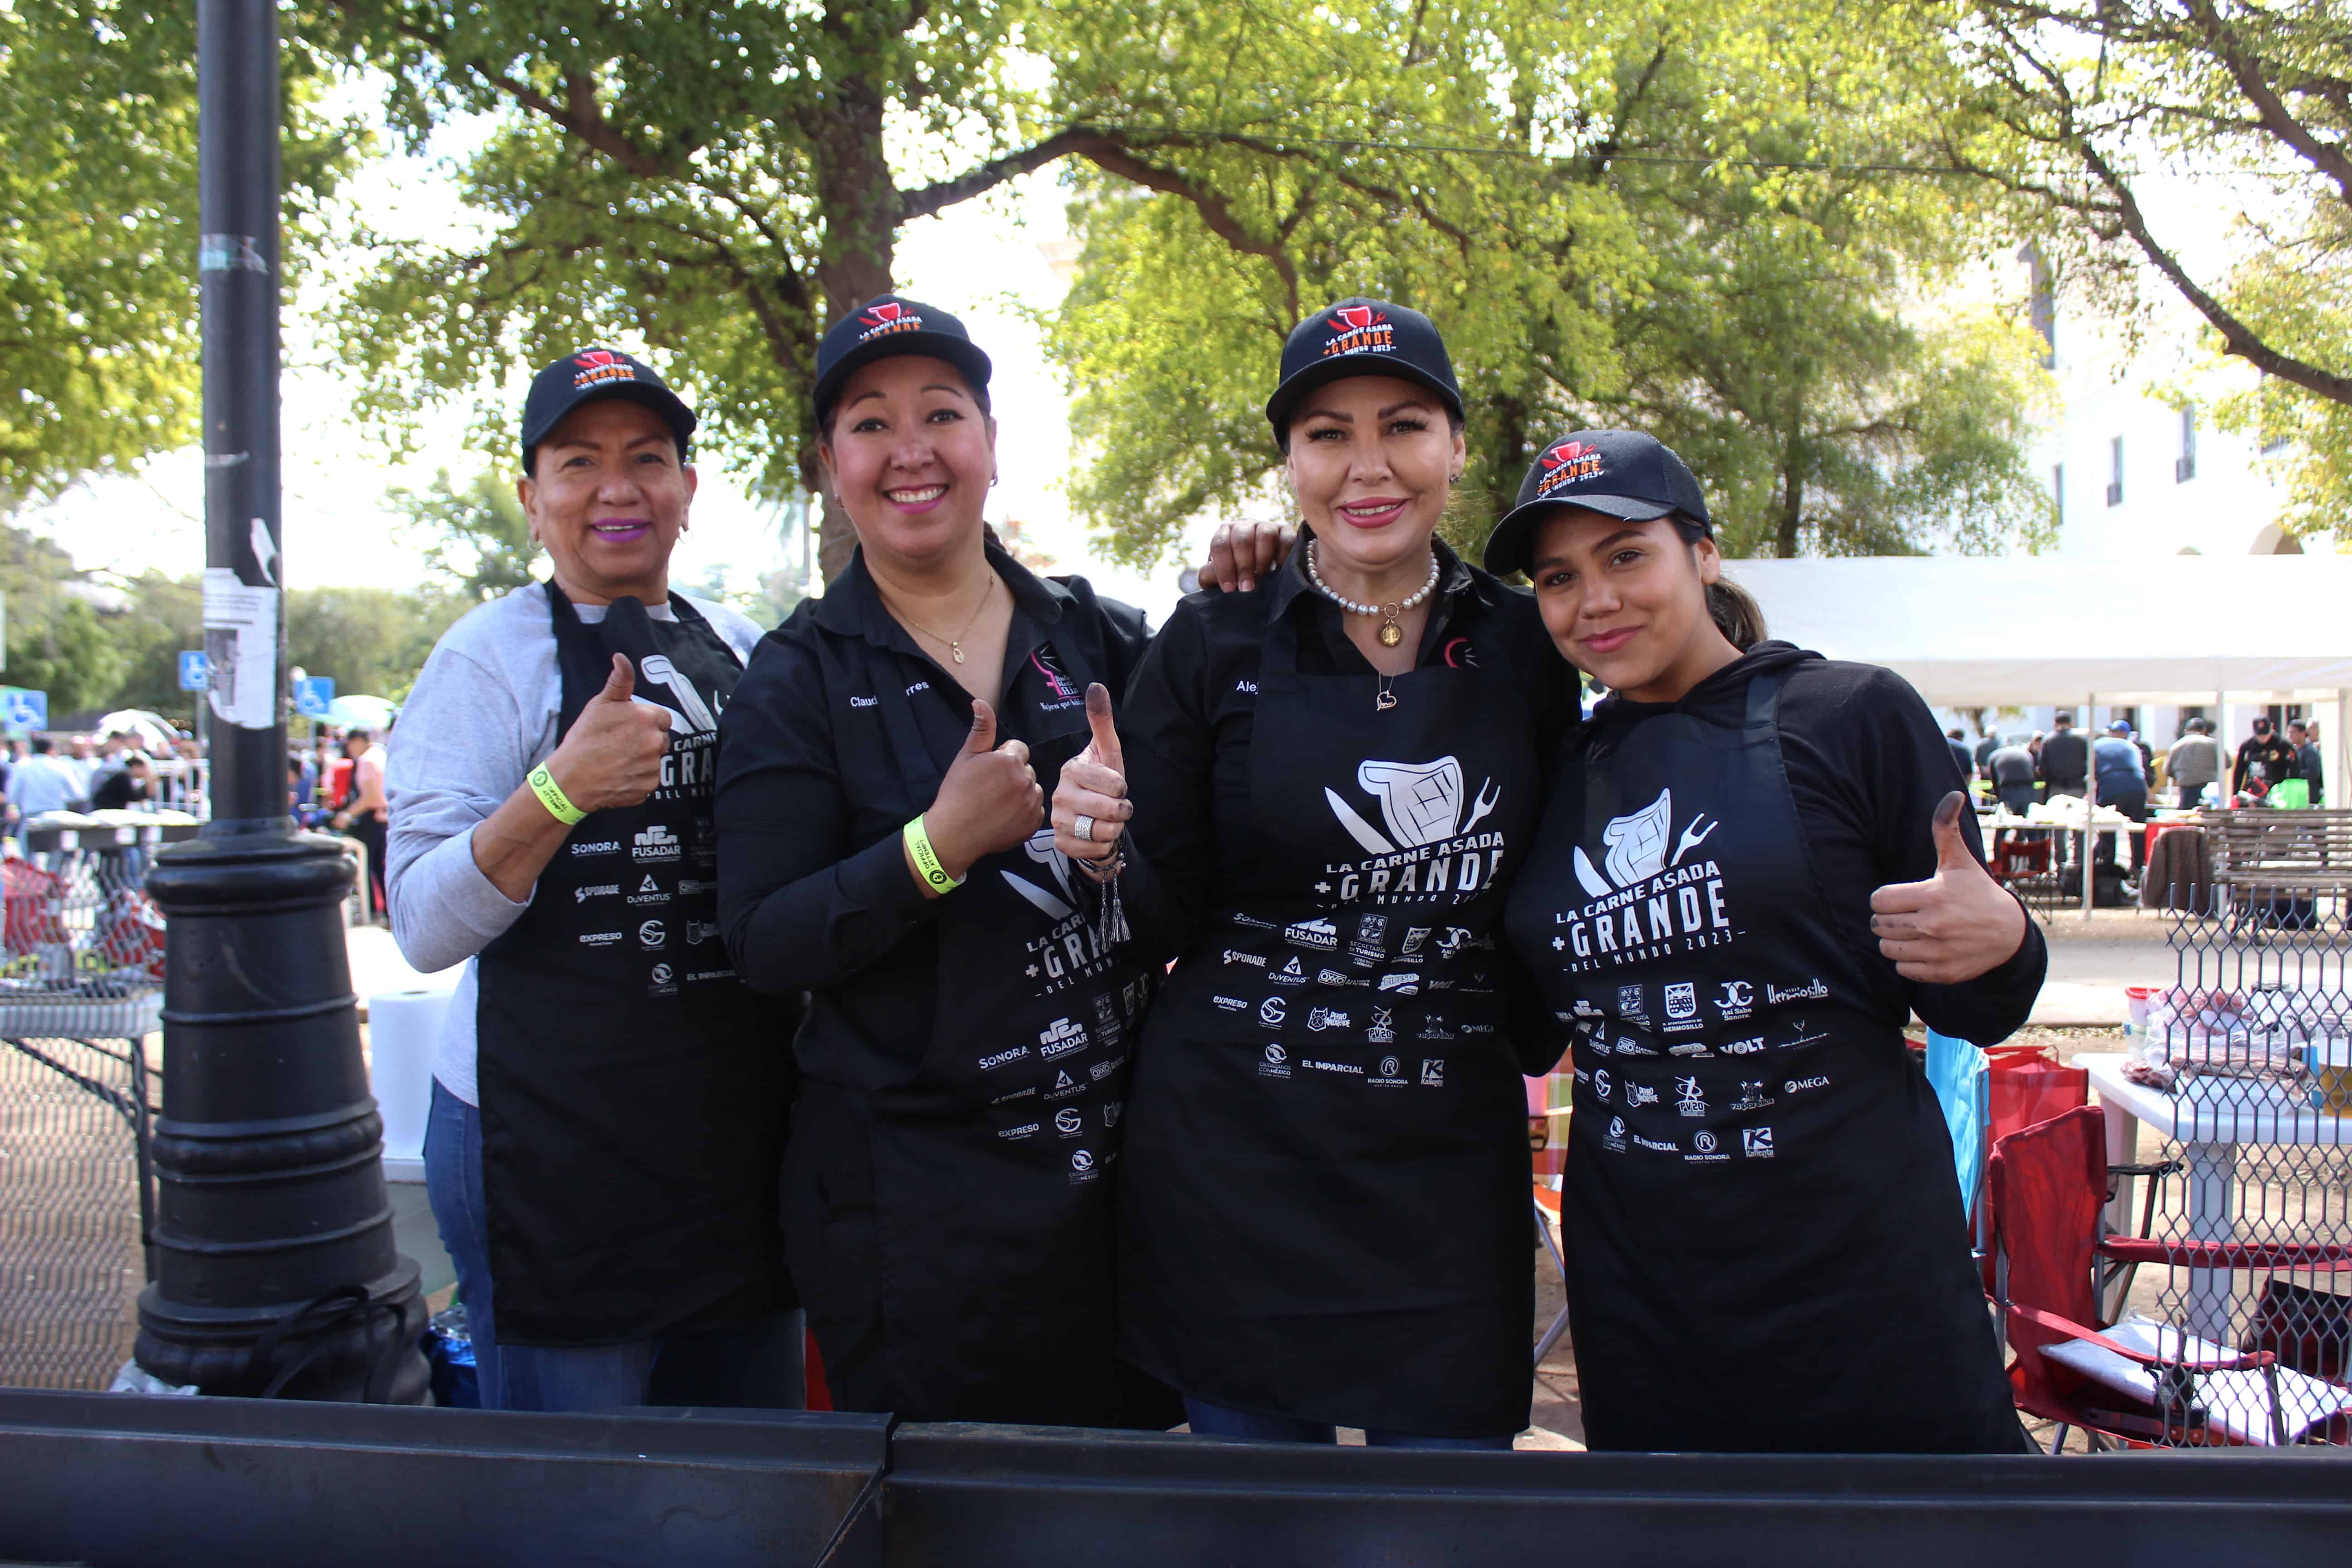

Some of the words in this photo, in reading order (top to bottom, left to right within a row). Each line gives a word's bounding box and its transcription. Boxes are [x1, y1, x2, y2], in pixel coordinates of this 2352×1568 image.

[896, 316, 922, 324] ASADA
[1326, 338, 1336, 346] LA
[1337, 327, 1365, 341] CARNE
[1366, 323, 1394, 333] ASADA
[1547, 460, 1572, 477] CARNE
[1572, 453, 1602, 464] ASADA
[850, 695, 878, 707] Claud
[906, 681, 930, 696] rres
[571, 841, 621, 855] SONORA
[632, 845, 681, 858] FUSADAR
[915, 841, 930, 869] OFFICIAL
[920, 839, 935, 866] ATTEMPT
[1326, 863, 1353, 873] LA
[1361, 846, 1431, 871] CARNE
[1437, 831, 1505, 857] ASADA
[1377, 894, 1438, 905] MUNDO
[1556, 910, 1579, 924] LA
[1584, 884, 1646, 917] CARNE
[1652, 861, 1720, 894] ASADA
[1026, 936, 1049, 952] LA
[1051, 911, 1086, 940] CAR
[1285, 928, 1338, 946] FUSADAR
[1232, 951, 1267, 967] SPORADE
[1356, 948, 1384, 959] TURISMO
[1614, 943, 1671, 965] MUNDO
[1320, 973, 1344, 984] OXXO
[1330, 1011, 1347, 1020] PERRO
[1663, 1023, 1704, 1032] HERMOSILLO
[1040, 1033, 1089, 1057] FUSADAR
[1720, 1037, 1764, 1054] VOLT
[979, 1045, 1030, 1069] SONORA
[1092, 1064, 1110, 1077] OXXO
[1302, 1059, 1314, 1068] EL
[1316, 1062, 1364, 1074] IMPARCIAL
[1798, 1076, 1829, 1089] MEGA
[1681, 1102, 1691, 1110] PV
[1693, 1102, 1704, 1110] 20
[1634, 1135, 1641, 1144] EL
